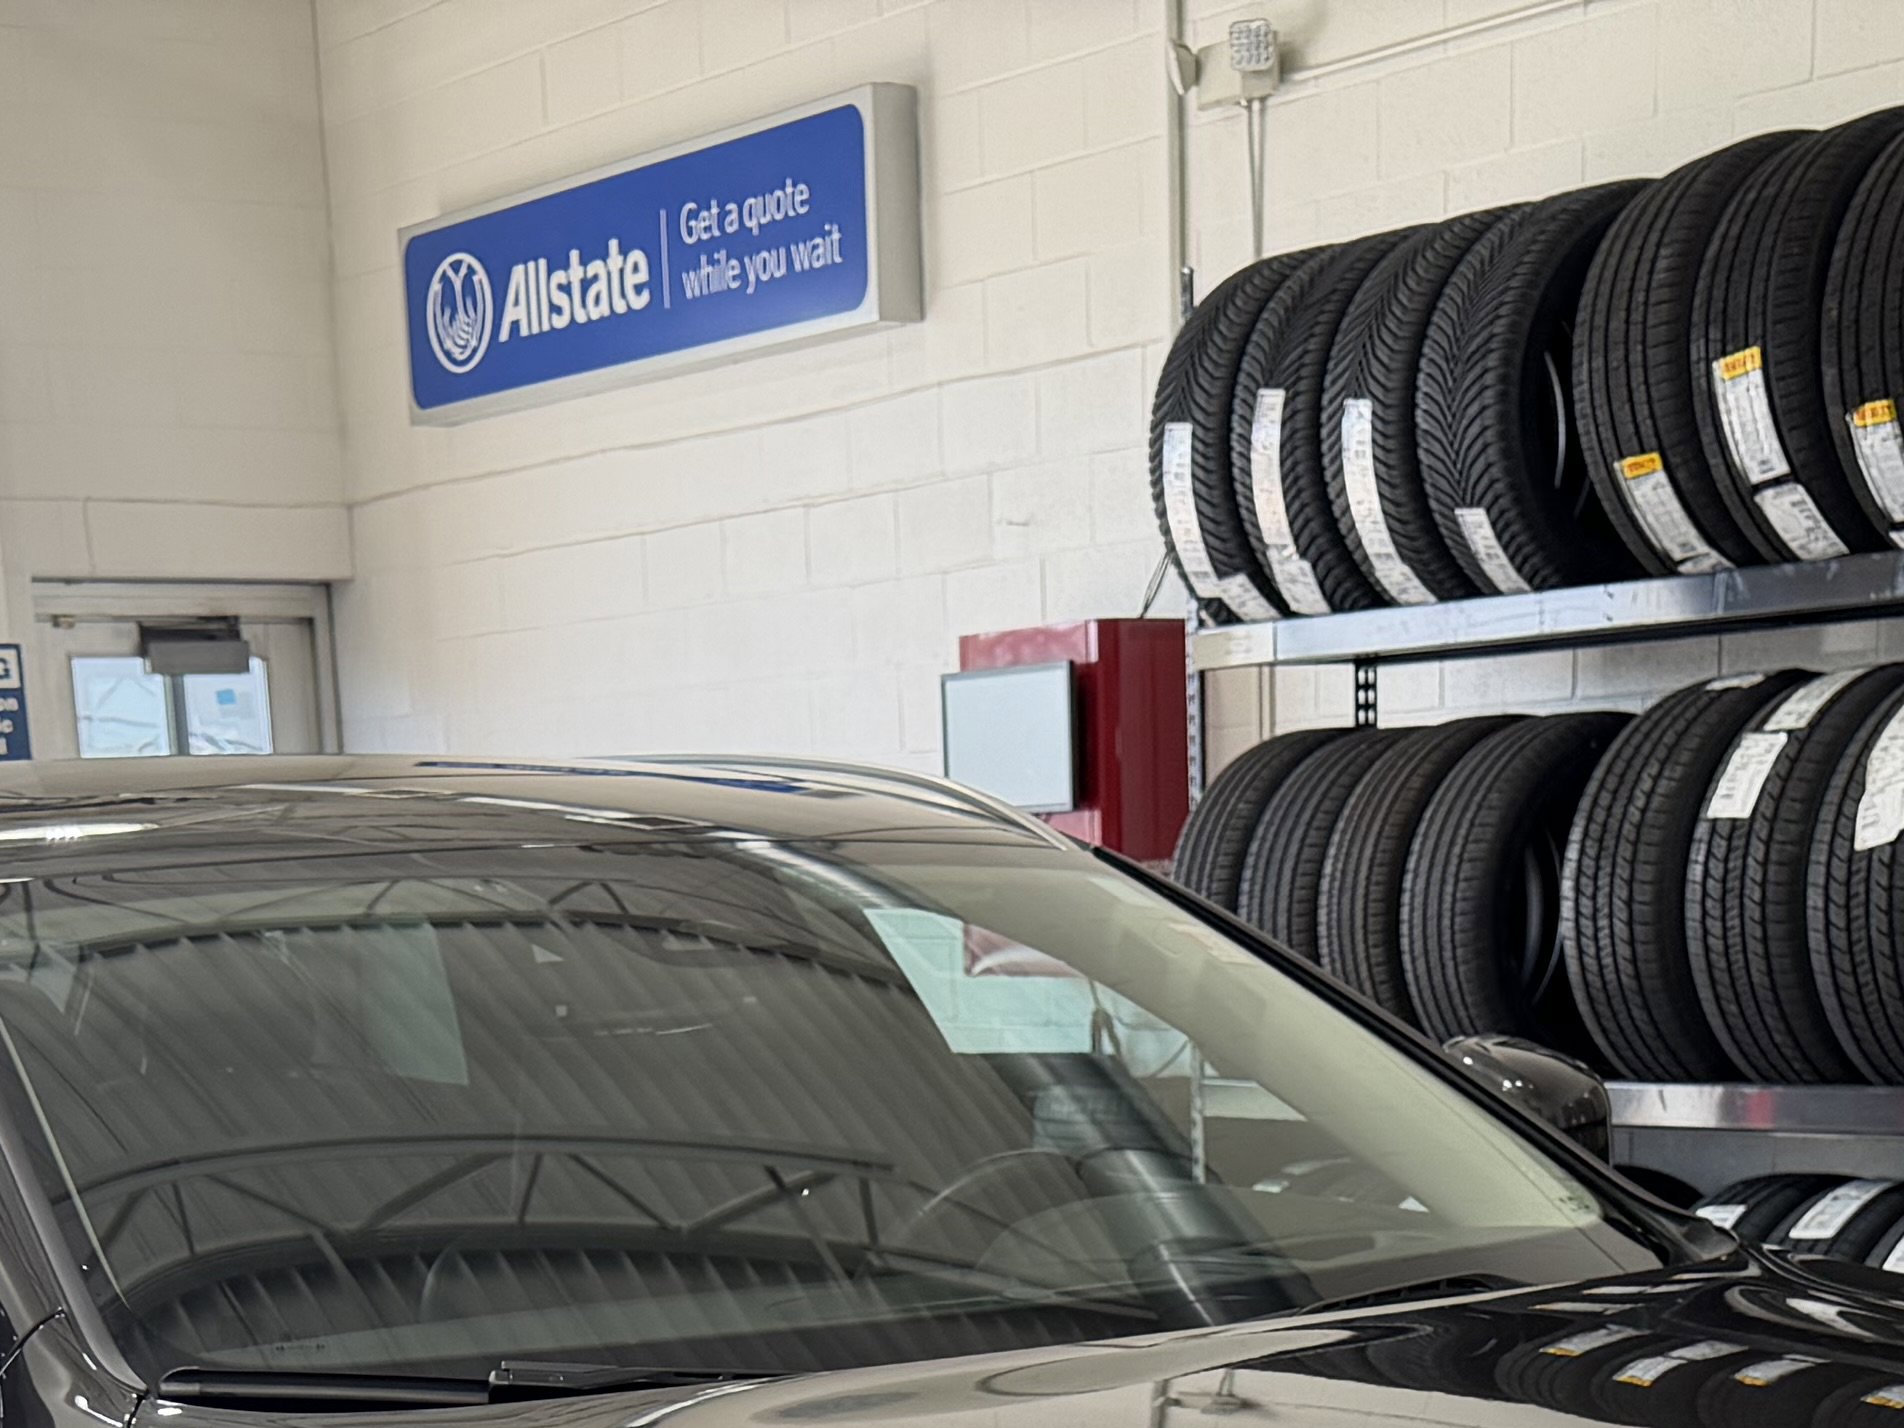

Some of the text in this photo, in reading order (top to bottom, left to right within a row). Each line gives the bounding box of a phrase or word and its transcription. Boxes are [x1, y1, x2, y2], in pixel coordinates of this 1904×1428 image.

[680, 178, 810, 245] Get a quote
[498, 239, 651, 343] Allstate
[681, 223, 843, 300] while you wait
